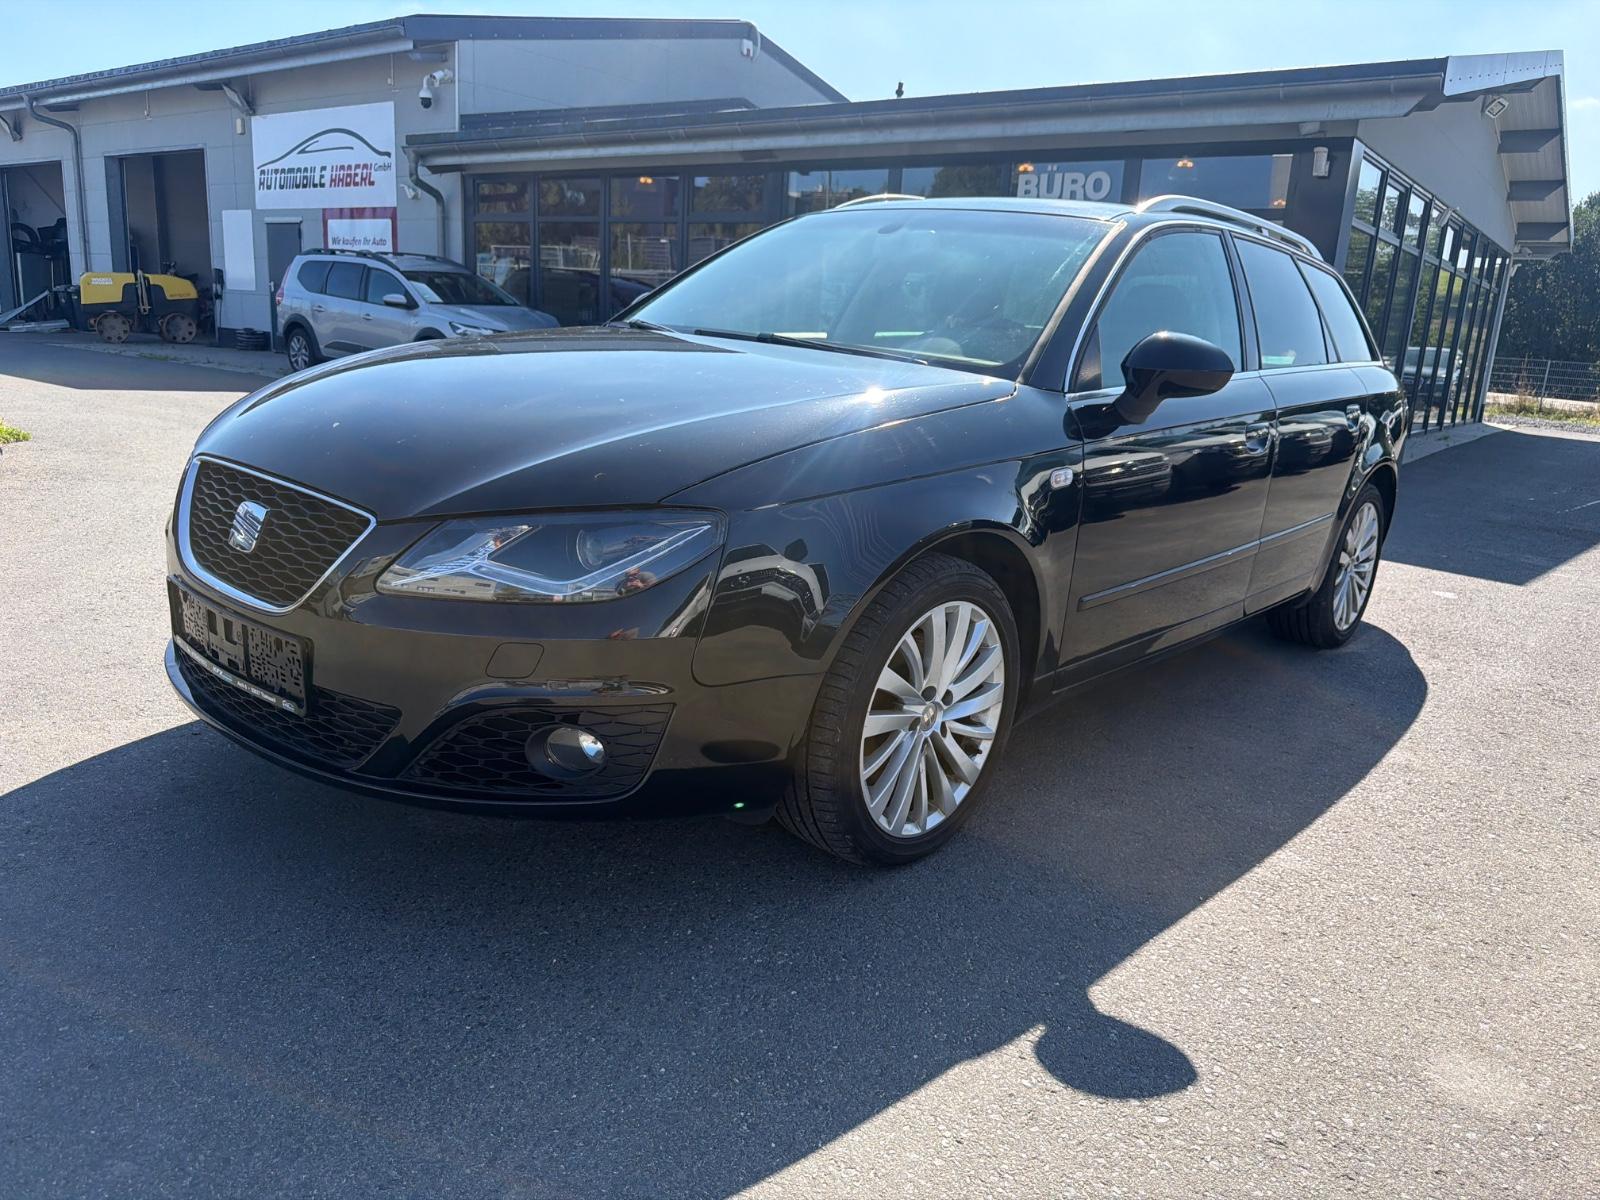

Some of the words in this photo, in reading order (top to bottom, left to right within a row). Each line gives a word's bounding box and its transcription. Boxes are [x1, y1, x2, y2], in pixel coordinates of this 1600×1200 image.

[258, 166, 327, 190] AUTOMOBILE
[329, 163, 375, 188] HABERL
[374, 162, 392, 172] GmbH
[1016, 165, 1111, 200] BÜRO
[331, 236, 341, 246] Wir
[342, 236, 361, 248] kaufen
[362, 236, 371, 246] Ihr
[371, 236, 387, 247] Auto
